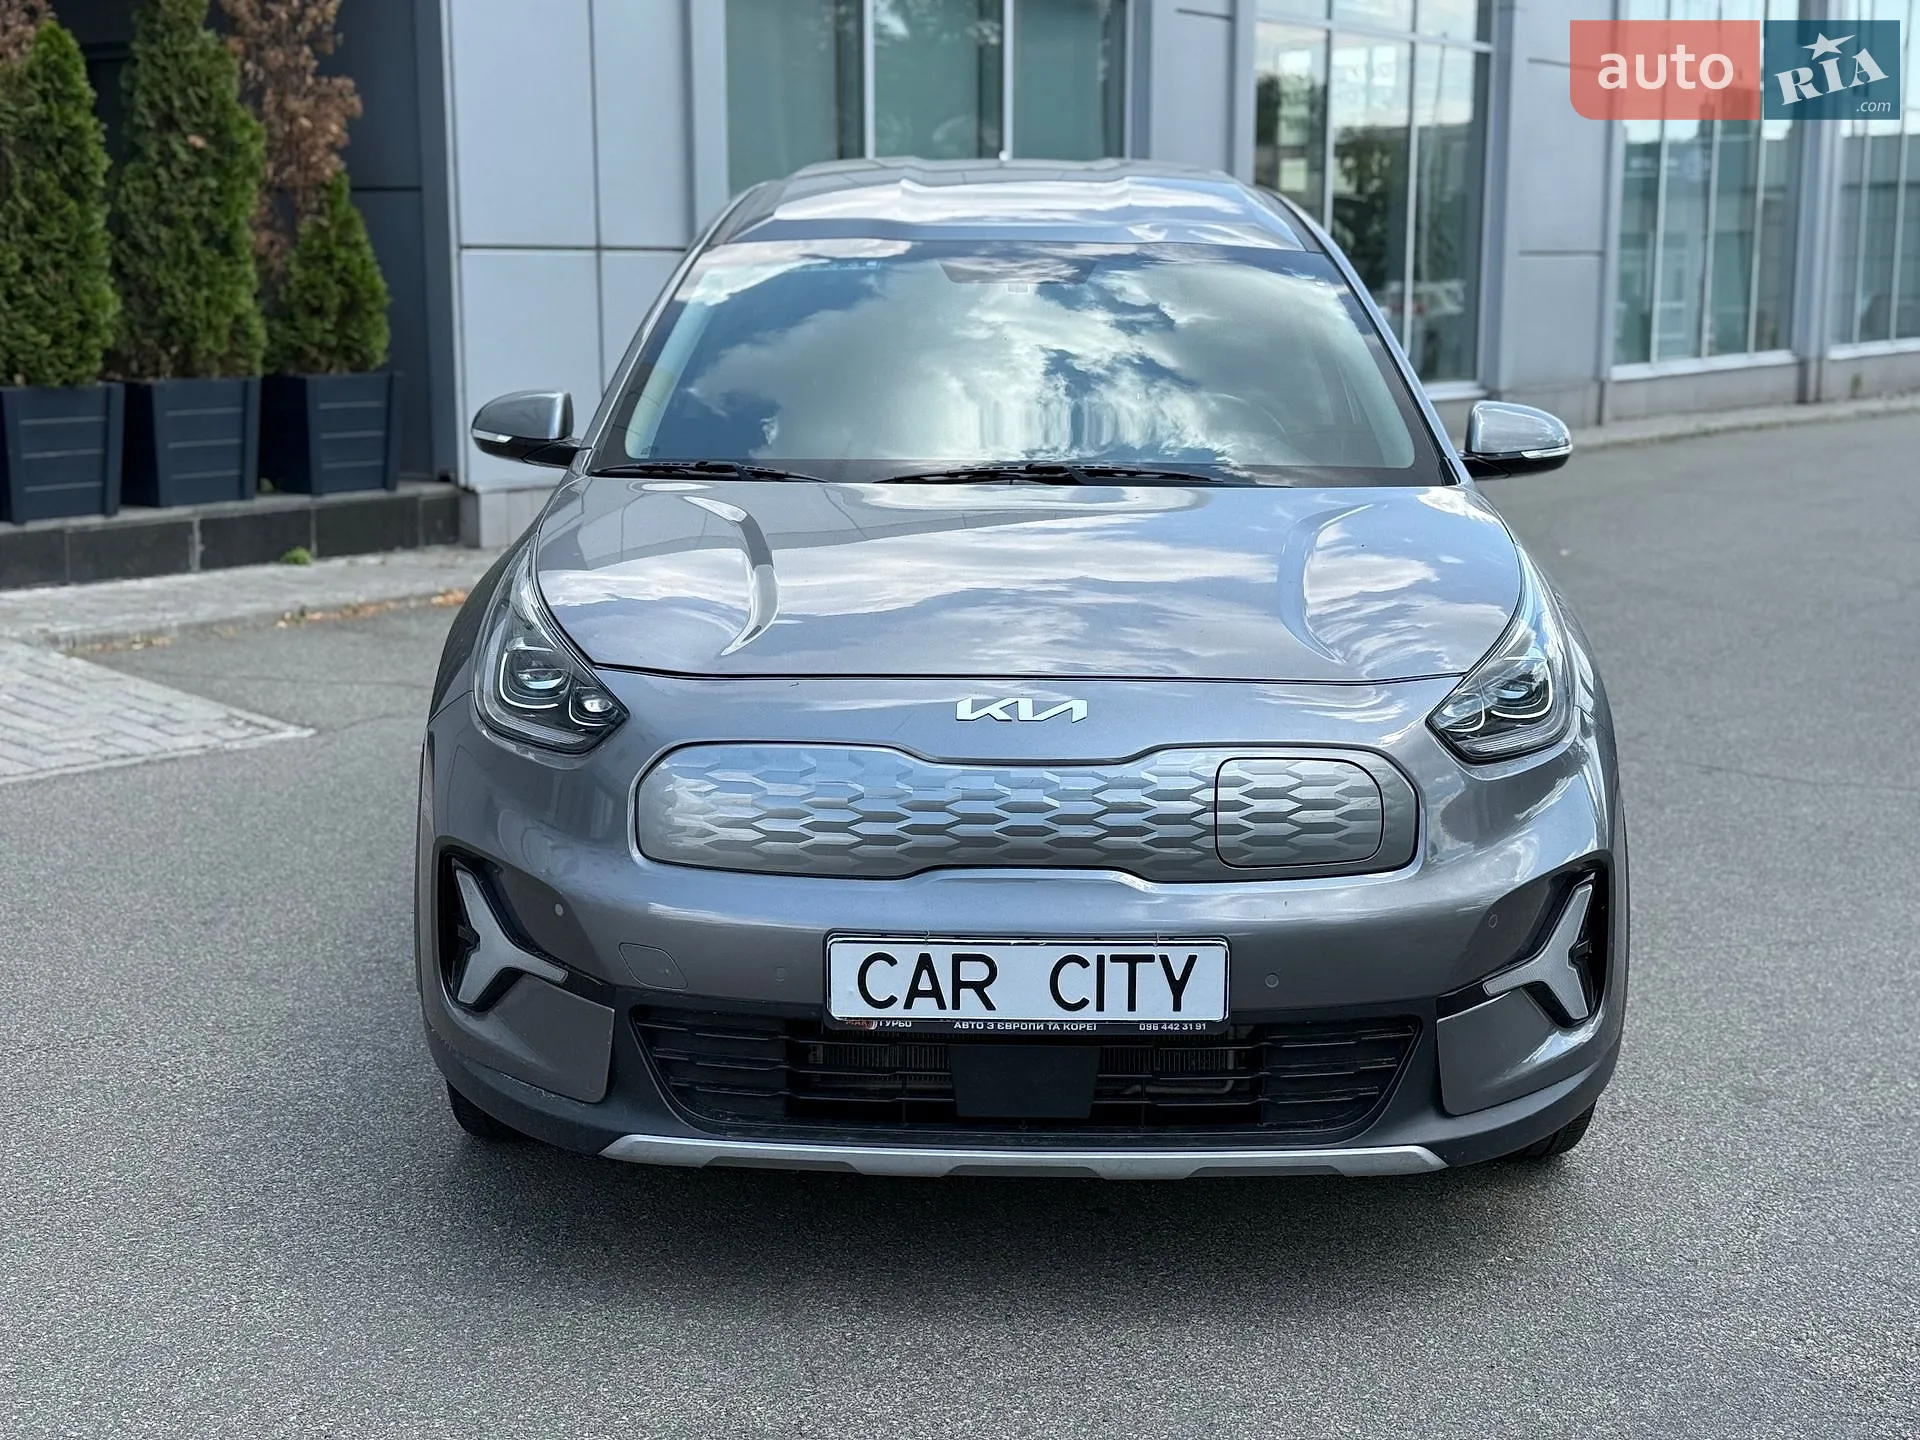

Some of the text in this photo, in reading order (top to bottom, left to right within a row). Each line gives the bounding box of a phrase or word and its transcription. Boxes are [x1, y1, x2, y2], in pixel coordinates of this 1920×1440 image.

[956, 697, 1088, 723] KIA
[857, 951, 1198, 1012] CAR CITY
[953, 1021, 984, 1030] АВТО
[997, 1022, 1044, 1031] ЄВРОПИ
[1160, 1023, 1180, 1031] 442
[1181, 1023, 1193, 1031] 31
